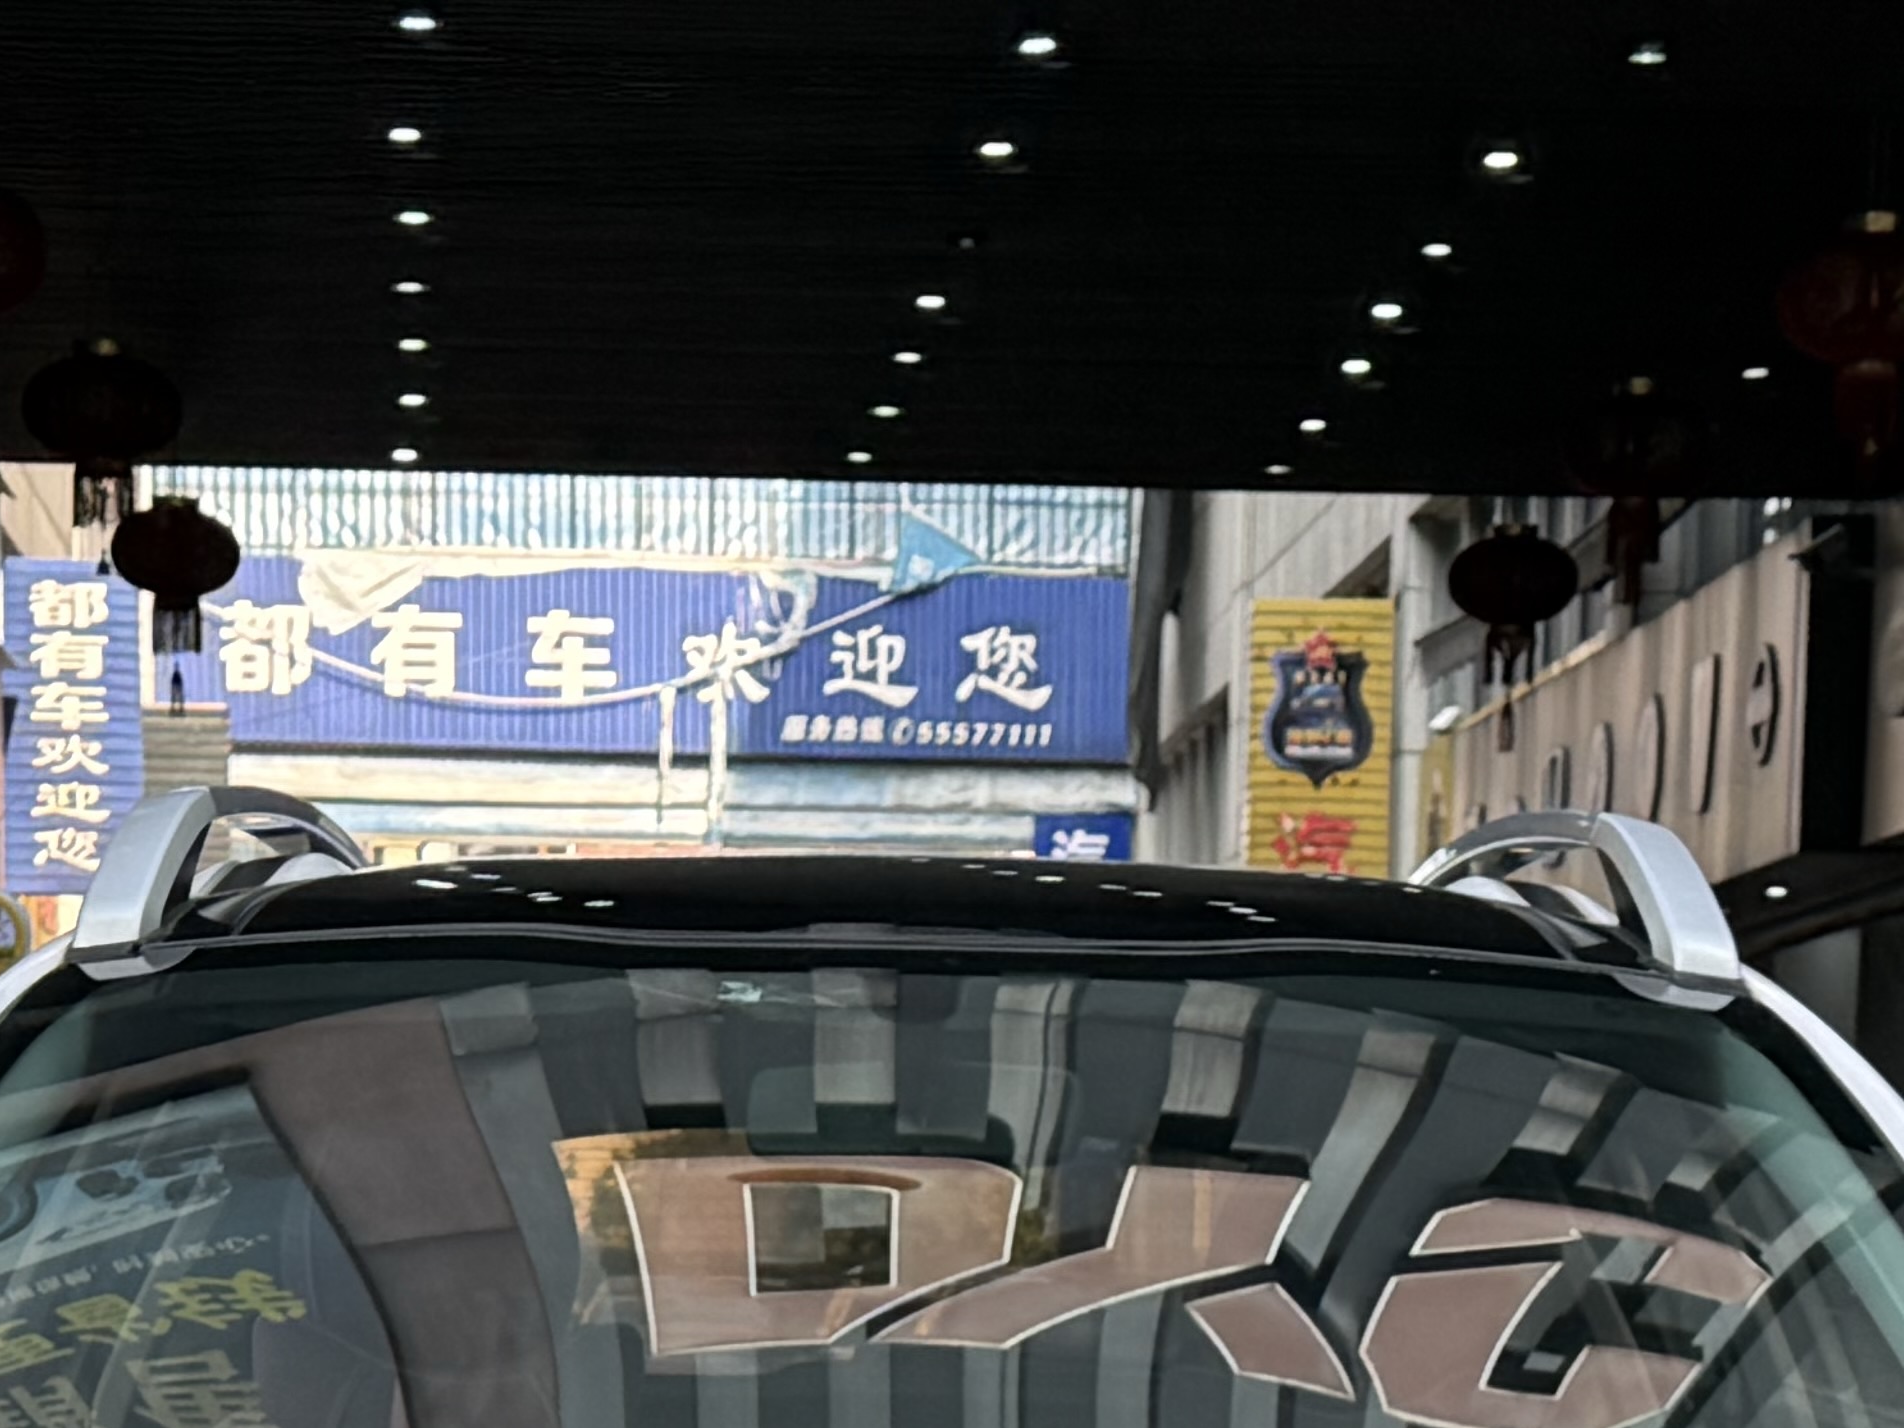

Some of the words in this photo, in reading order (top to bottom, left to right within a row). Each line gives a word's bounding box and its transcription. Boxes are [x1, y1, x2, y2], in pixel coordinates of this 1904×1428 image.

[217, 598, 1054, 712] 都有车欢迎您
[28, 578, 112, 873] 都有车欢迎您
[914, 720, 1053, 748] 55577111
